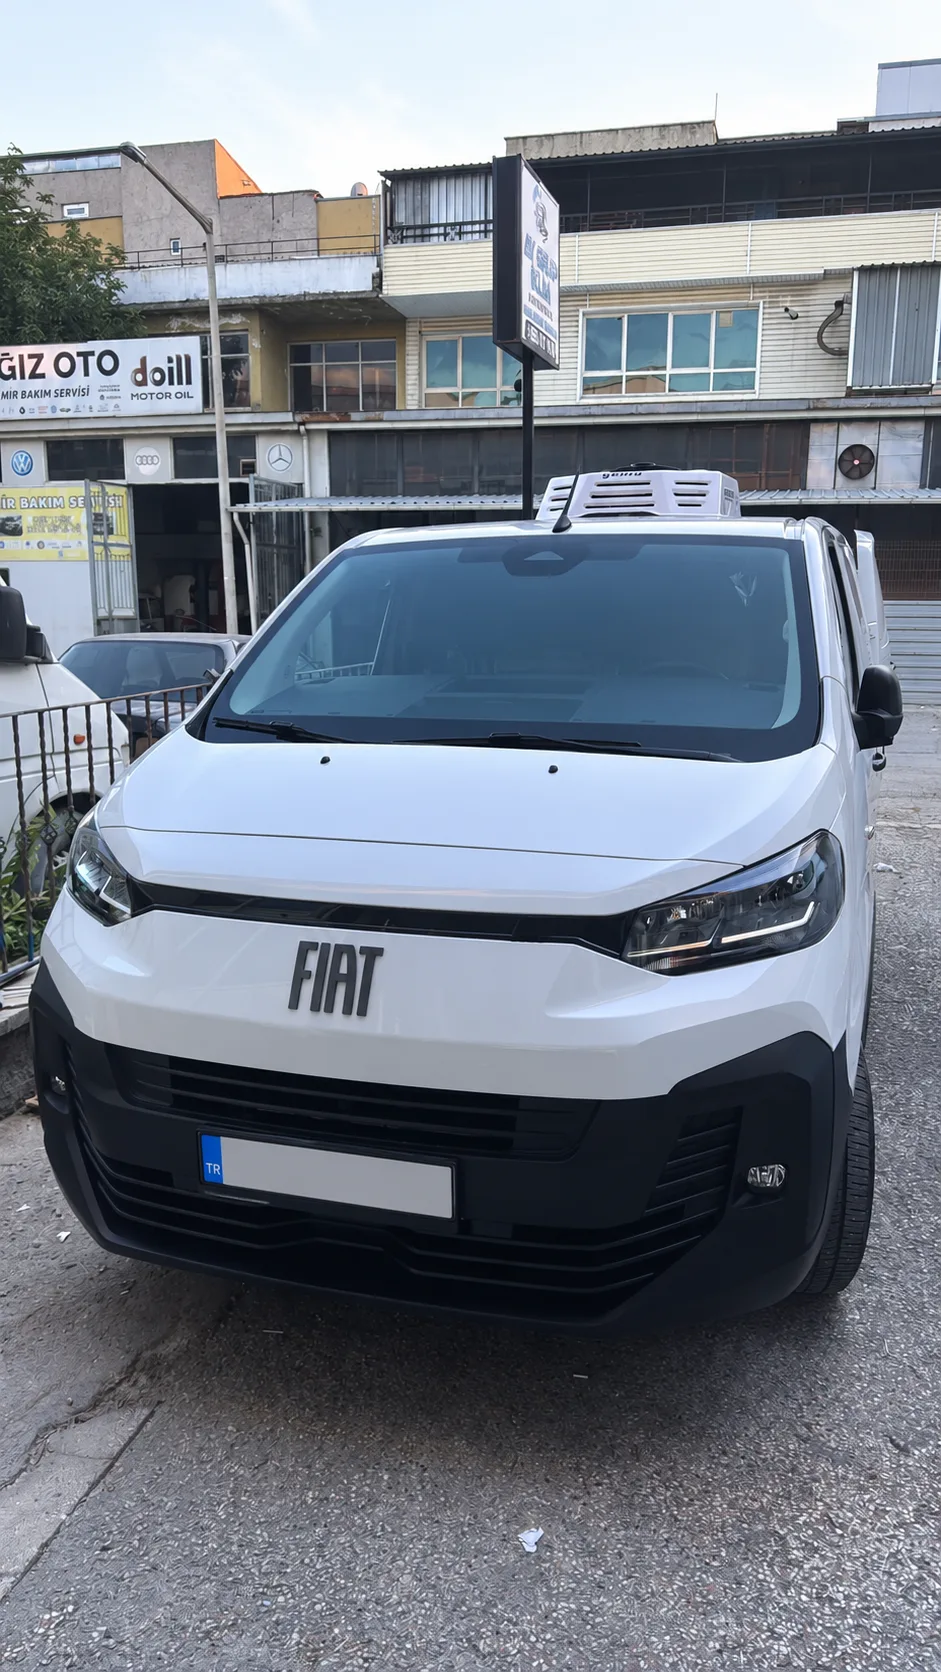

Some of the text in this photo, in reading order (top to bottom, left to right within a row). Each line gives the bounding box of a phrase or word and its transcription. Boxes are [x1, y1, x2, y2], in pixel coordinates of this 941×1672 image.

[53, 349, 120, 379] OTO
[130, 354, 193, 387] doill
[20, 389, 52, 400] BAKIM
[54, 385, 90, 399] SERVİSİ
[130, 392, 172, 401] MOTOR
[176, 390, 194, 400] OIL
[20, 495, 65, 509] BAKIM
[288, 940, 385, 1017] FIAT
[205, 1162, 221, 1176] TR
